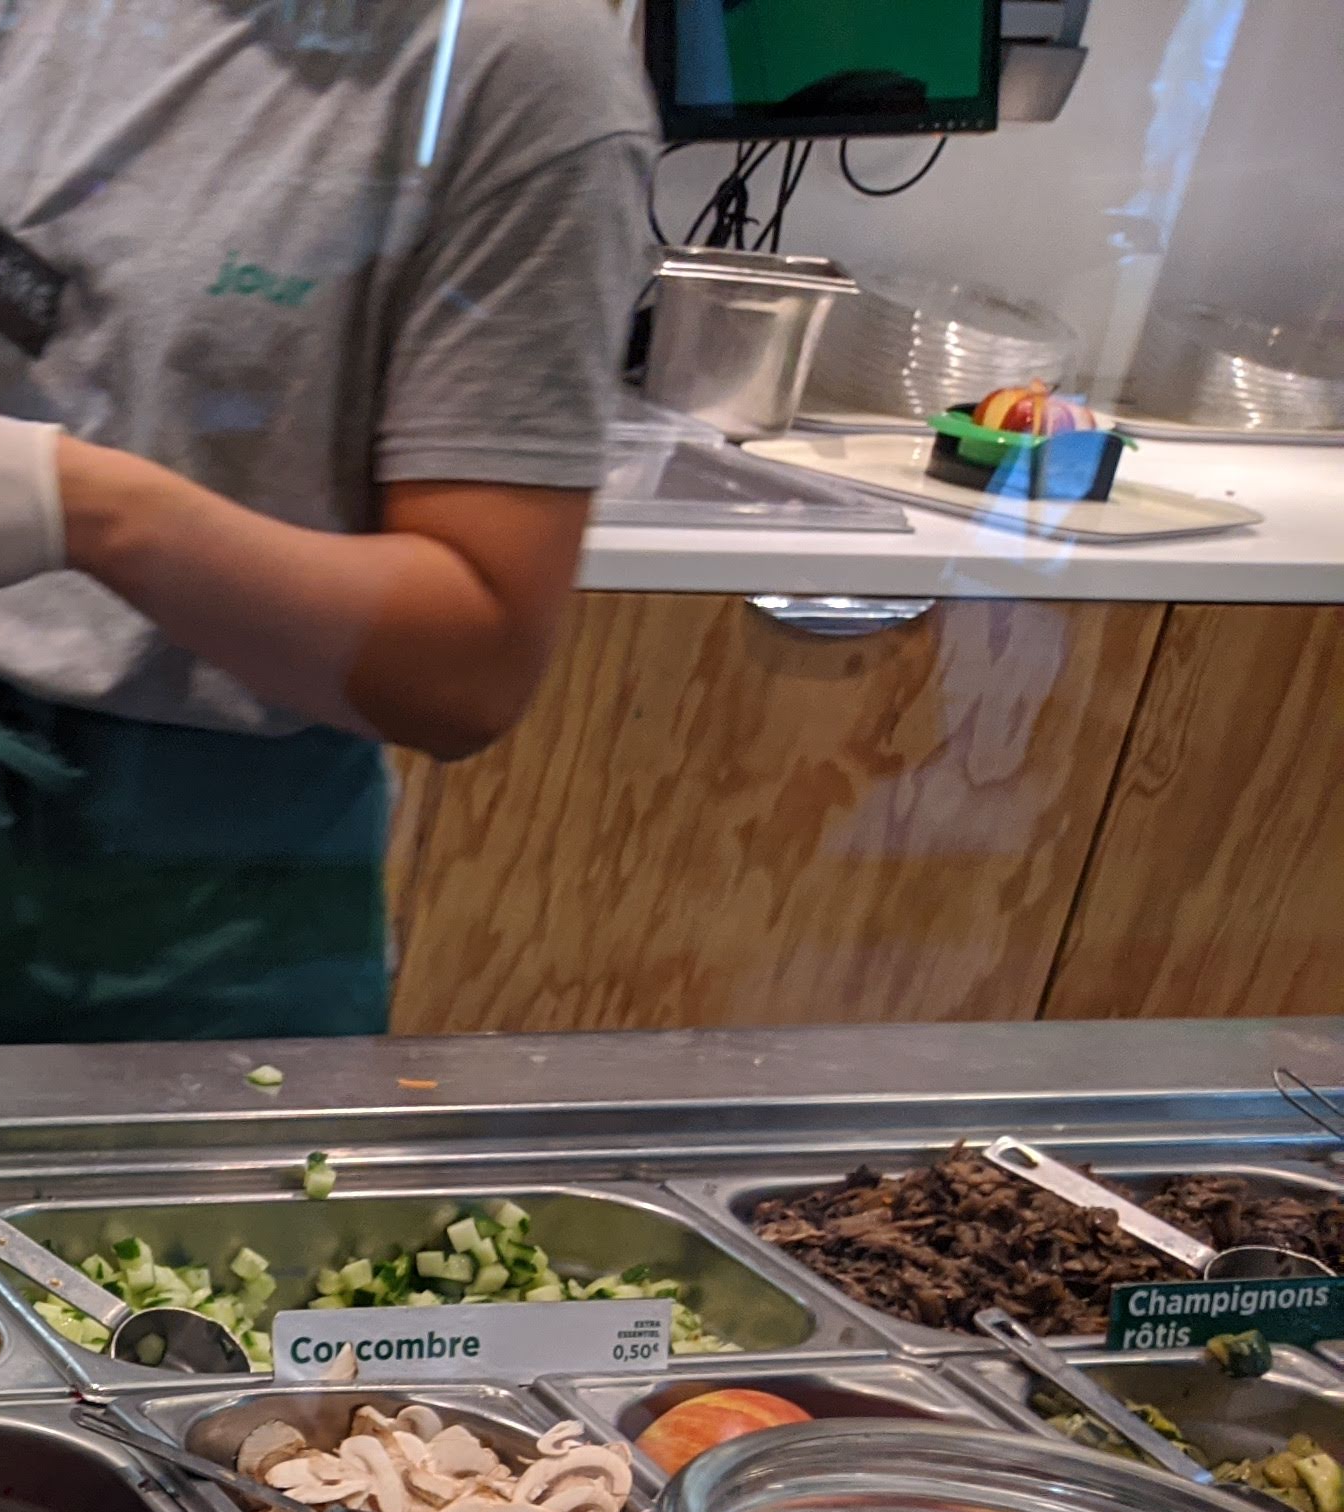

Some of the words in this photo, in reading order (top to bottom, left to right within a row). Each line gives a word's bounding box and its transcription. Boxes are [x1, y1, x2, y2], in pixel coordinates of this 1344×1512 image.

[1127, 1285, 1331, 1318] Champignons
[1122, 1321, 1192, 1350] rôtis
[613, 1342, 659, 1362] 0,50€
